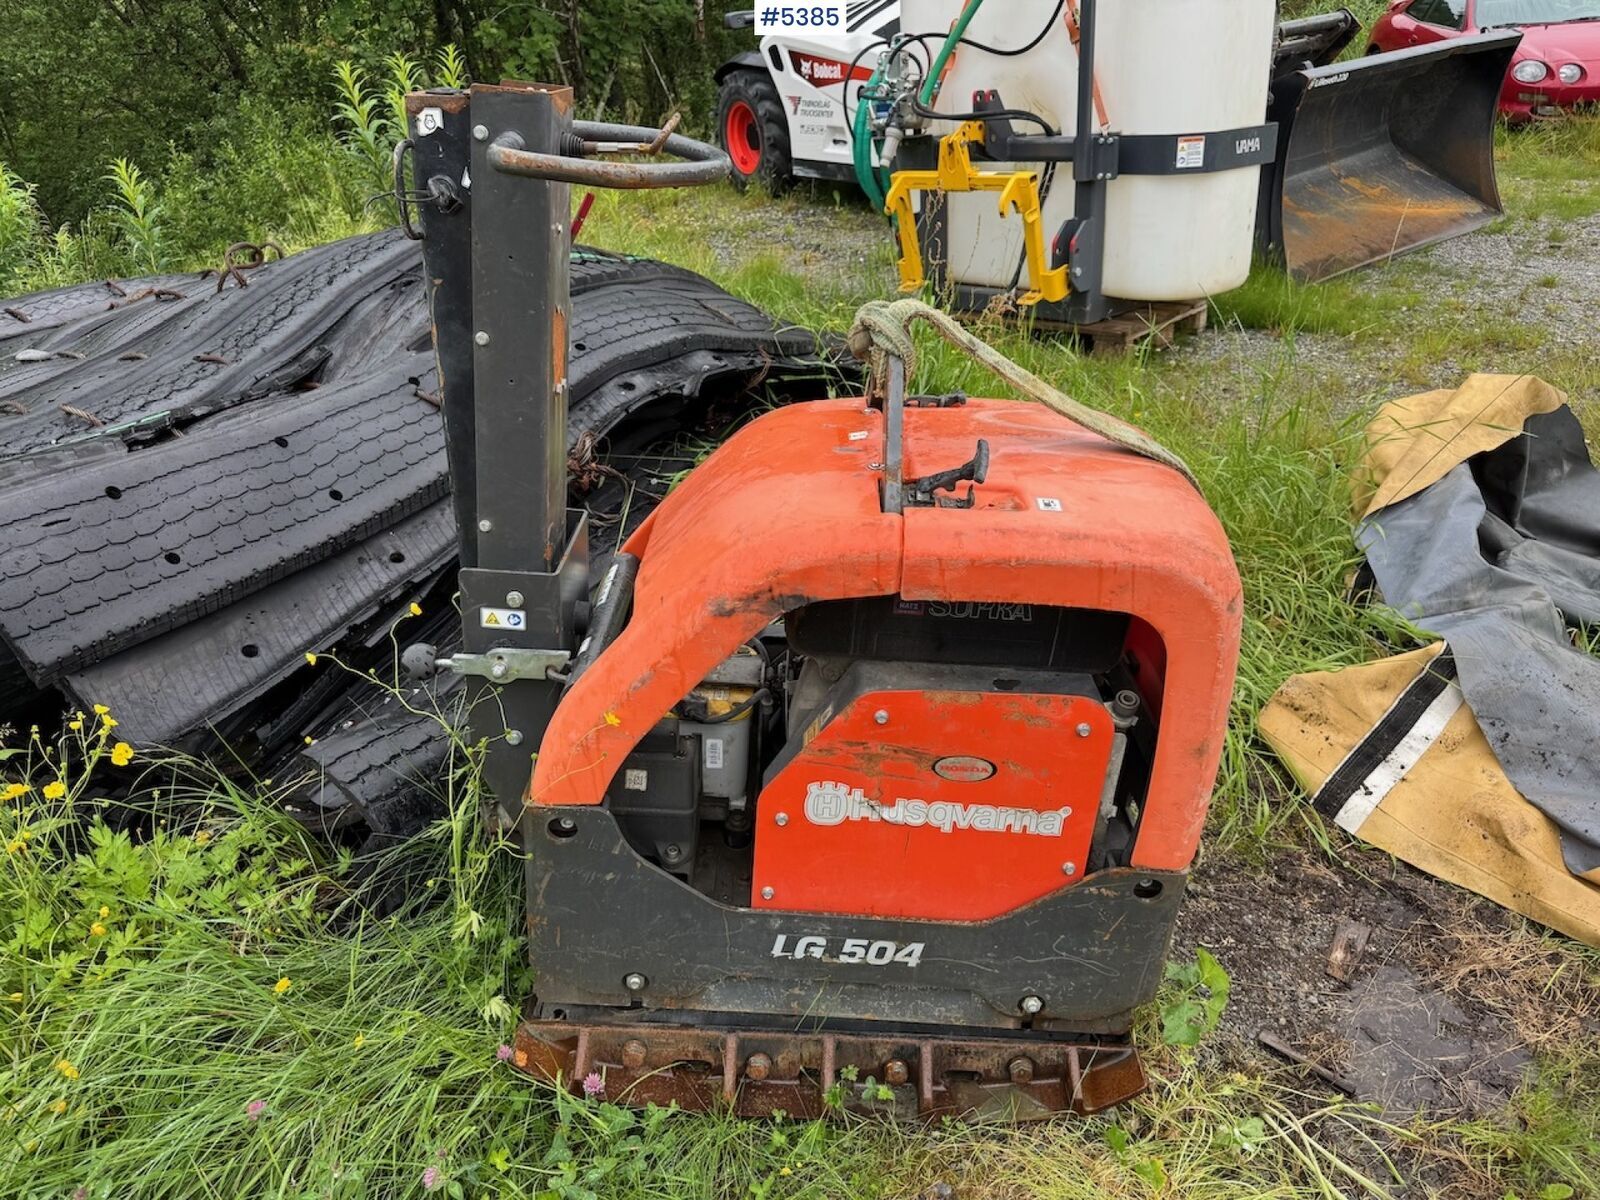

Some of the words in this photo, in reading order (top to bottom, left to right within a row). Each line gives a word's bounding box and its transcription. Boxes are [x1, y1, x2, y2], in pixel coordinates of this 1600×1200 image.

[813, 62, 843, 79] Bobcat
[928, 600, 1033, 621] SUPRA
[851, 788, 1063, 836] Husqvarna
[770, 934, 827, 960] LG
[839, 938, 925, 967] 504
